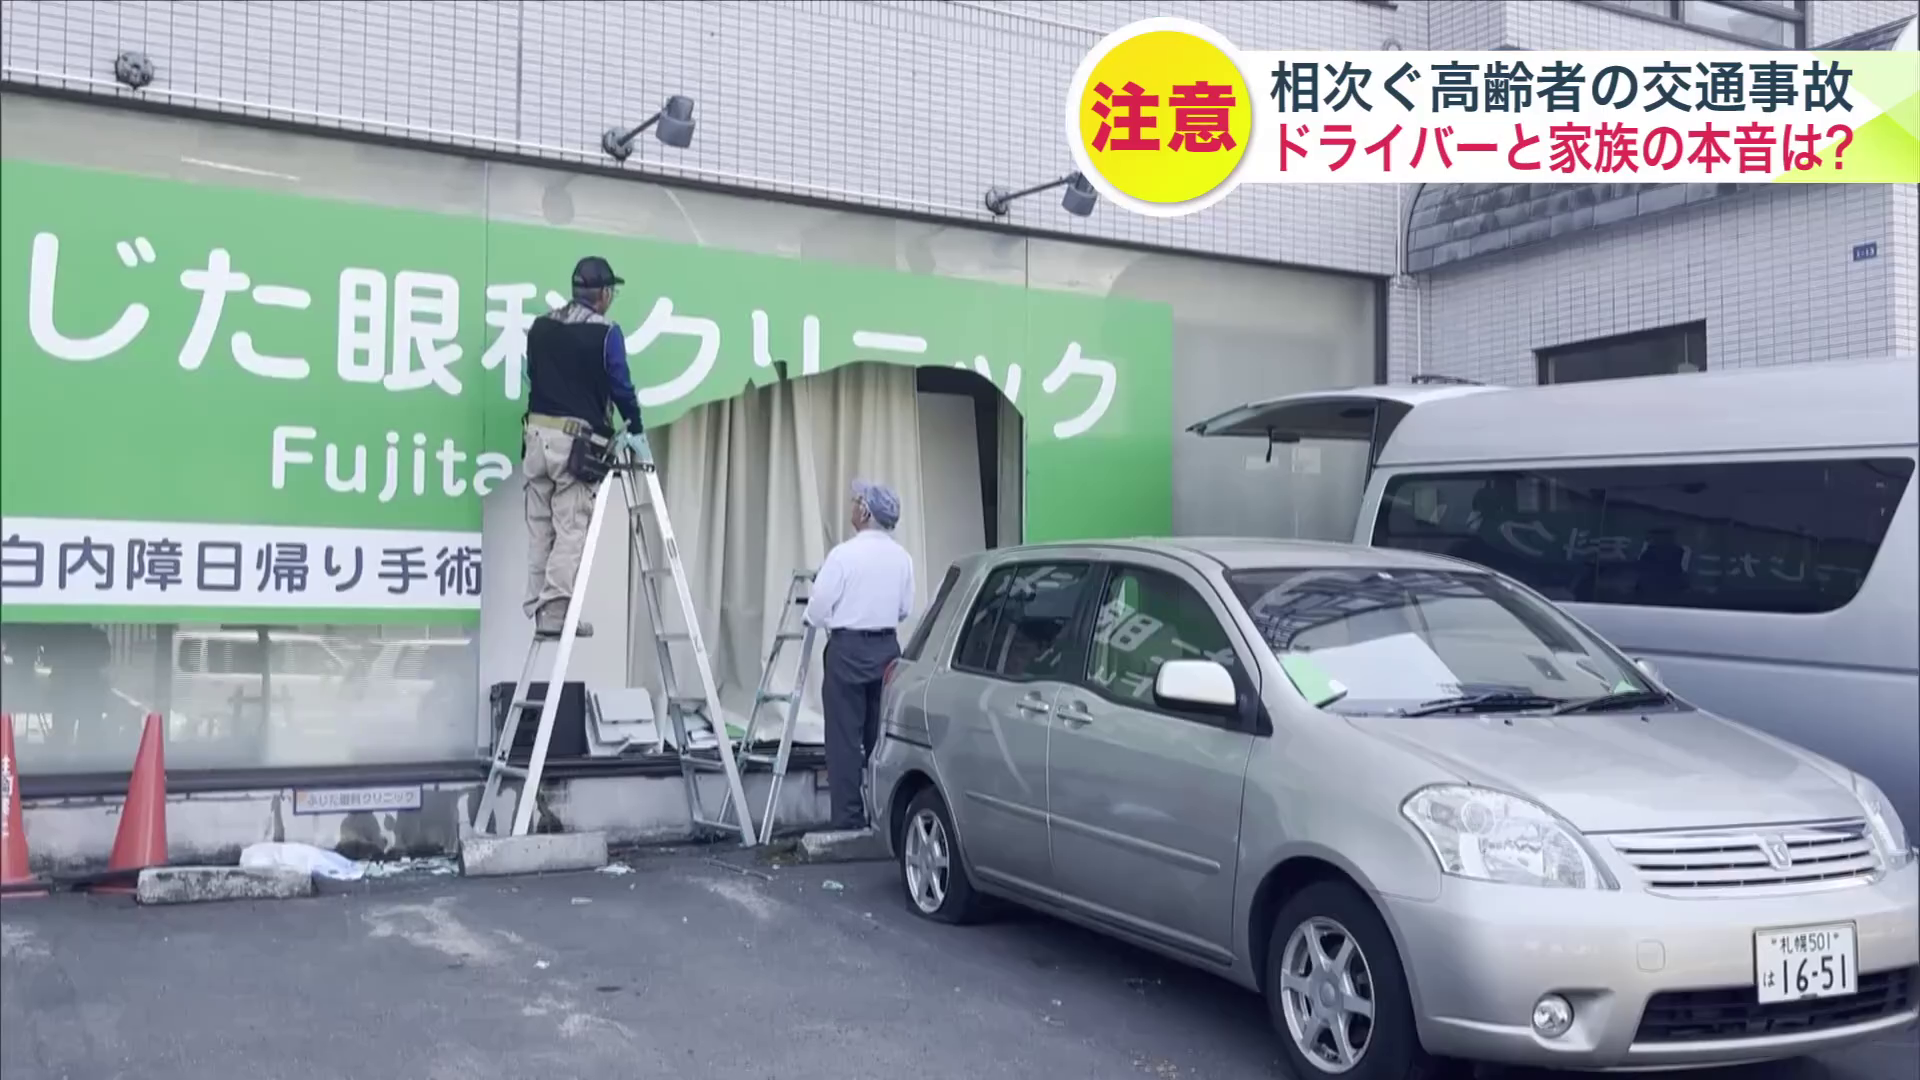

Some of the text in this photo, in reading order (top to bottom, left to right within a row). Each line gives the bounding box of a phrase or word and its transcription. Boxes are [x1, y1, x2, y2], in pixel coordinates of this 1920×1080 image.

[271, 425, 513, 502] Fujita
[0, 534, 482, 596] 白内障日帰り手術
[1763, 953, 1847, 995] は 16-51
